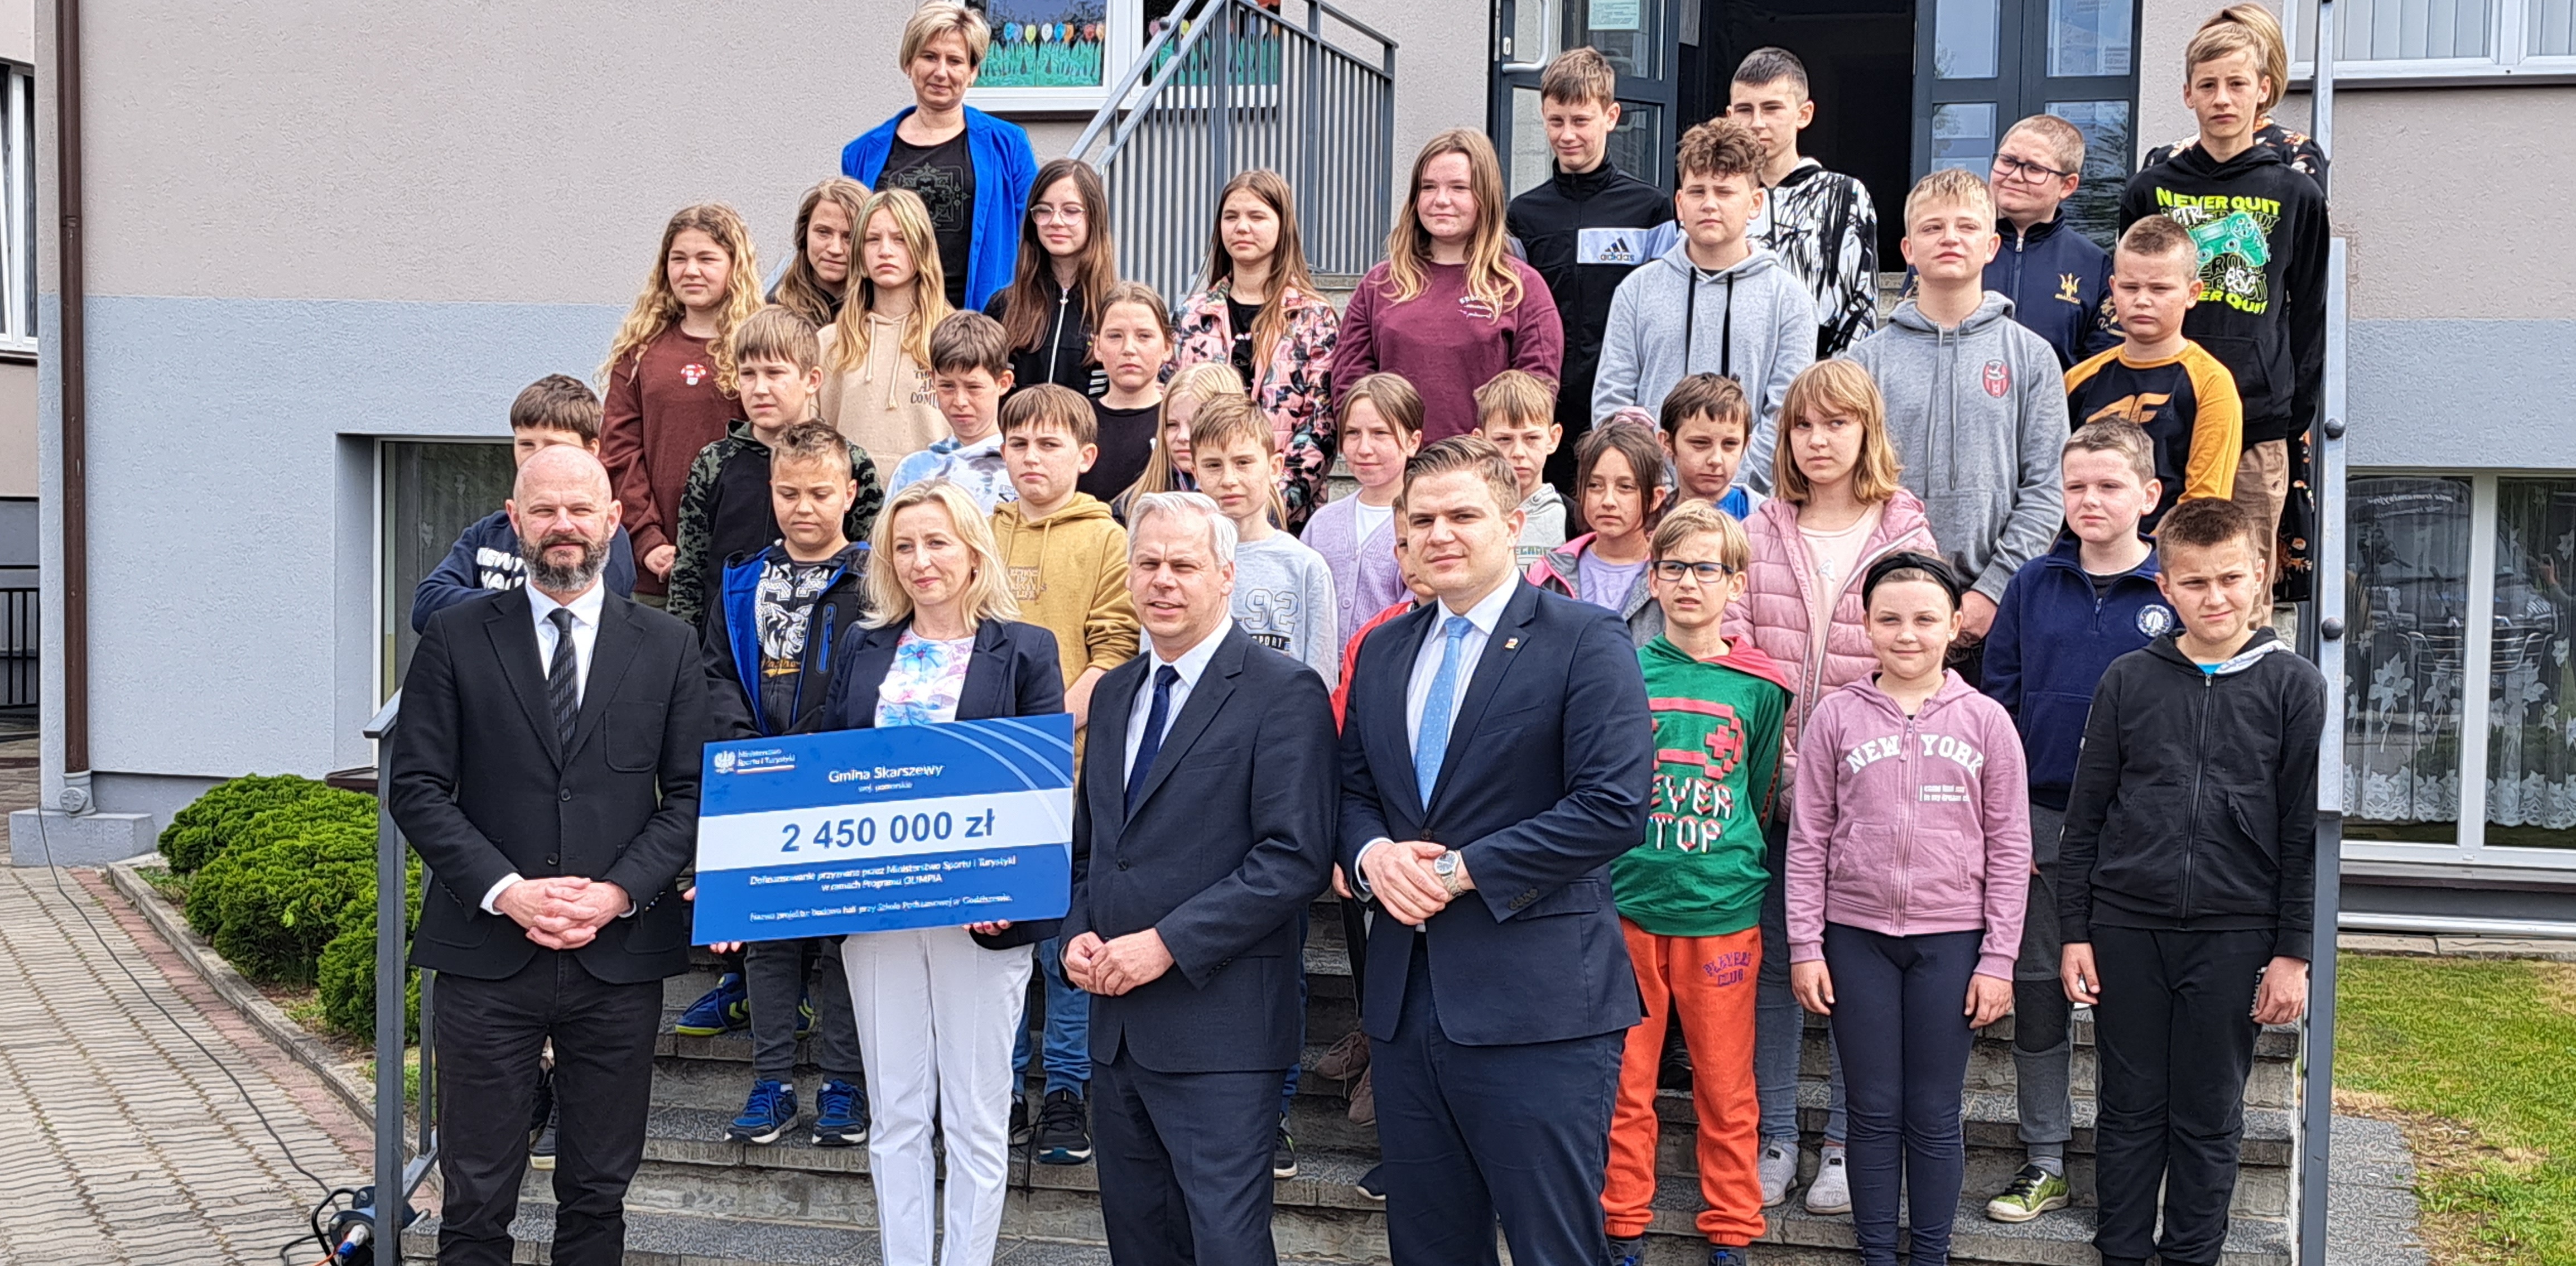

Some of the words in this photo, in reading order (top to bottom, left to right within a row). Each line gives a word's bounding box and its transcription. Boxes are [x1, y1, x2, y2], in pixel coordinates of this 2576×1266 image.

[2156, 187, 2228, 210] NEVER
[2231, 196, 2280, 215] QUIT
[1600, 252, 1635, 261] adidas
[1244, 588, 1299, 634] 92
[829, 769, 870, 782] Gmina
[874, 766, 945, 778] Skarszewy
[1846, 735, 1900, 774] NEW
[1920, 734, 1984, 779] YORK
[1651, 774, 1734, 820] EVER
[781, 824, 800, 851] 2
[813, 817, 875, 848] 450
[890, 812, 952, 843] 000
[965, 808, 994, 837] zł
[1648, 812, 1722, 853] TOP
[943, 860, 971, 870] Sportu
